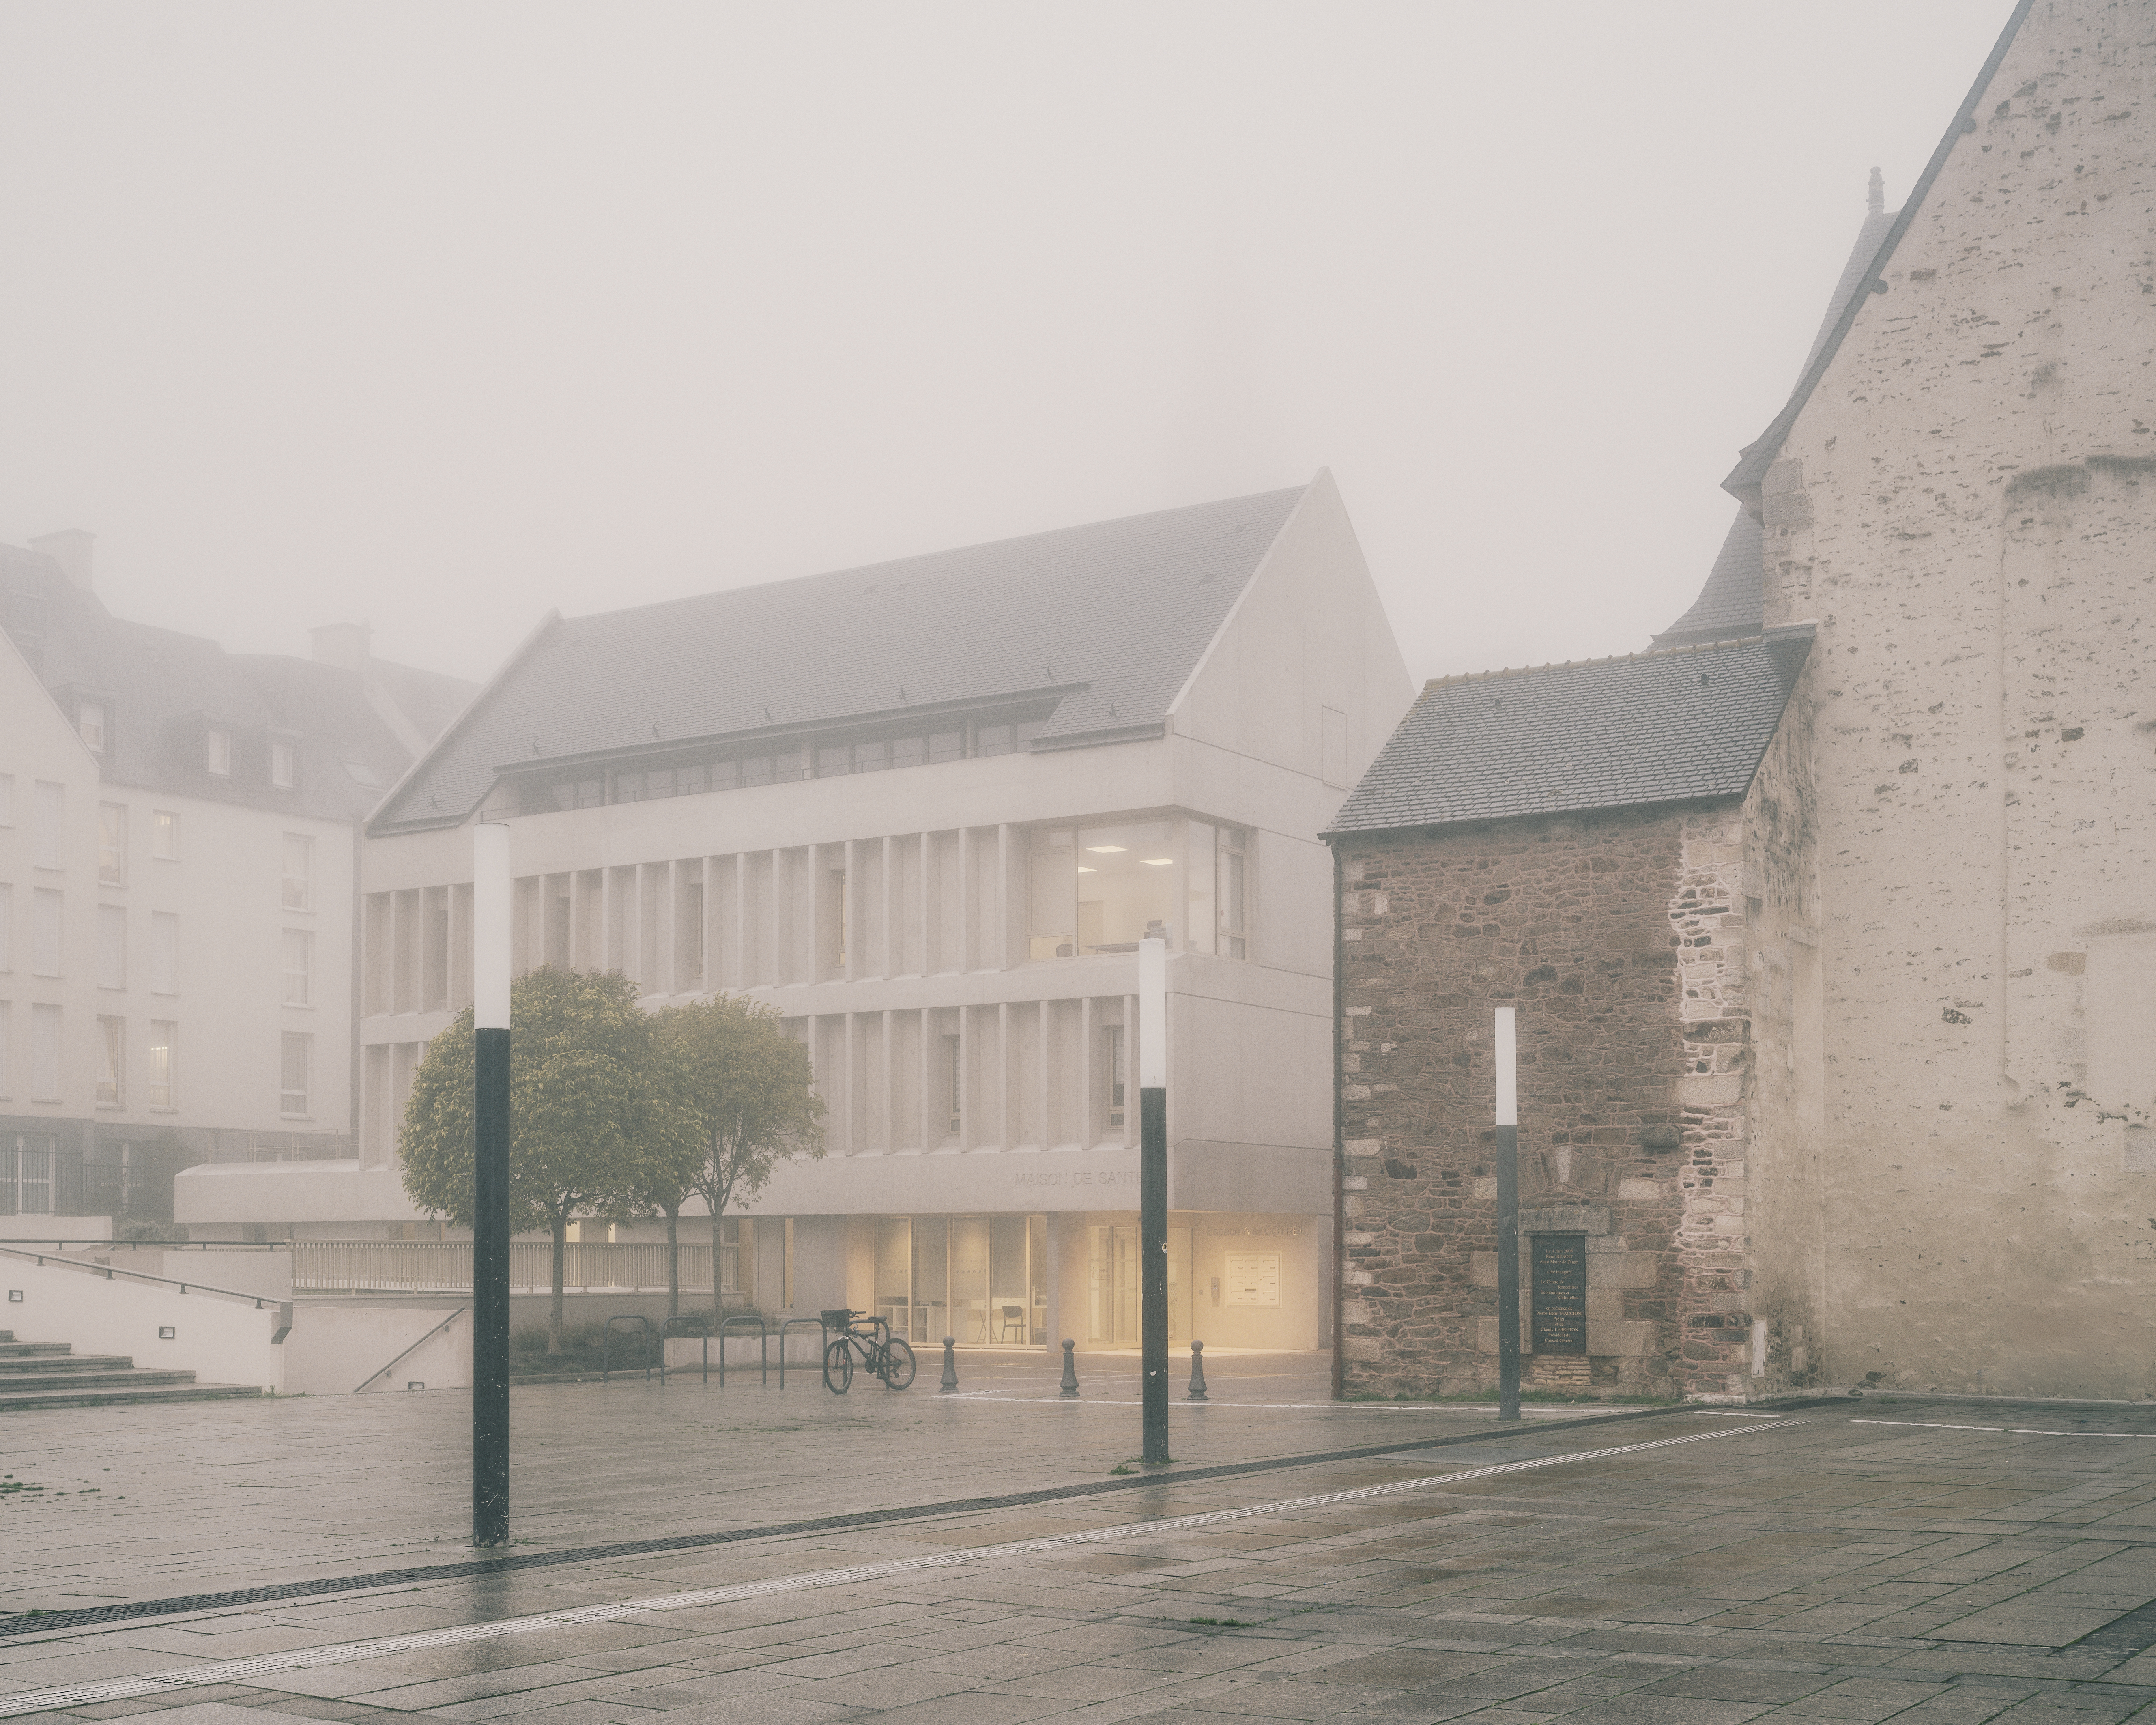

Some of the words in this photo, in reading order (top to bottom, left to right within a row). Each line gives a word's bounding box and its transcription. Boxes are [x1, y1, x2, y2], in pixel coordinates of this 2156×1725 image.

[1015, 1172, 1068, 1186] MAISON
[1074, 1172, 1092, 1185] DE
[1207, 1226, 1240, 1239] Espace
[1241, 1226, 1262, 1236] Yves
[1264, 1225, 1306, 1236] COTREL
